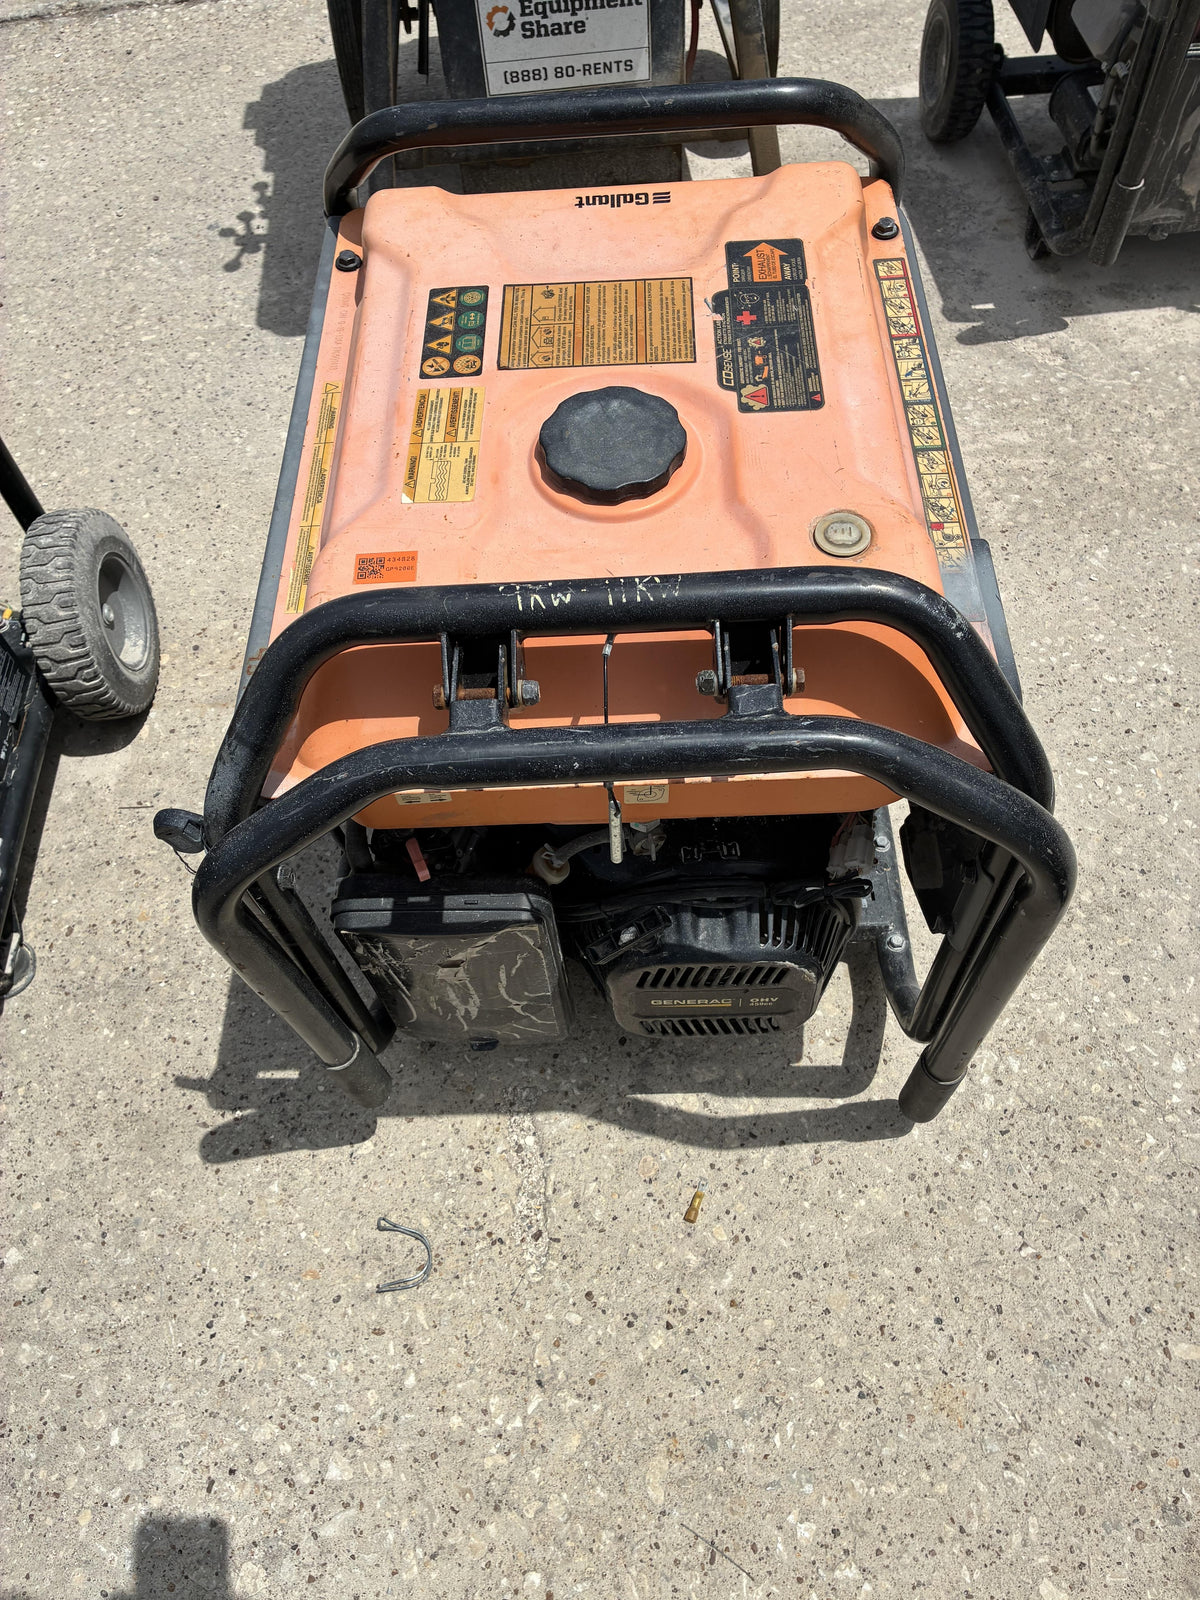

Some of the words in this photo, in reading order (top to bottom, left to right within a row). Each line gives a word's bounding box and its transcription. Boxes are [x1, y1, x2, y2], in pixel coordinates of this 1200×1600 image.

[520, 19, 587, 39] Share
[504, 67, 548, 84] (888)
[554, 60, 634, 78] 80-RENTS
[574, 192, 650, 208] Gallant
[732, 264, 740, 282] POINT
[756, 250, 767, 280] EXHAUST
[782, 263, 792, 280] AWAY
